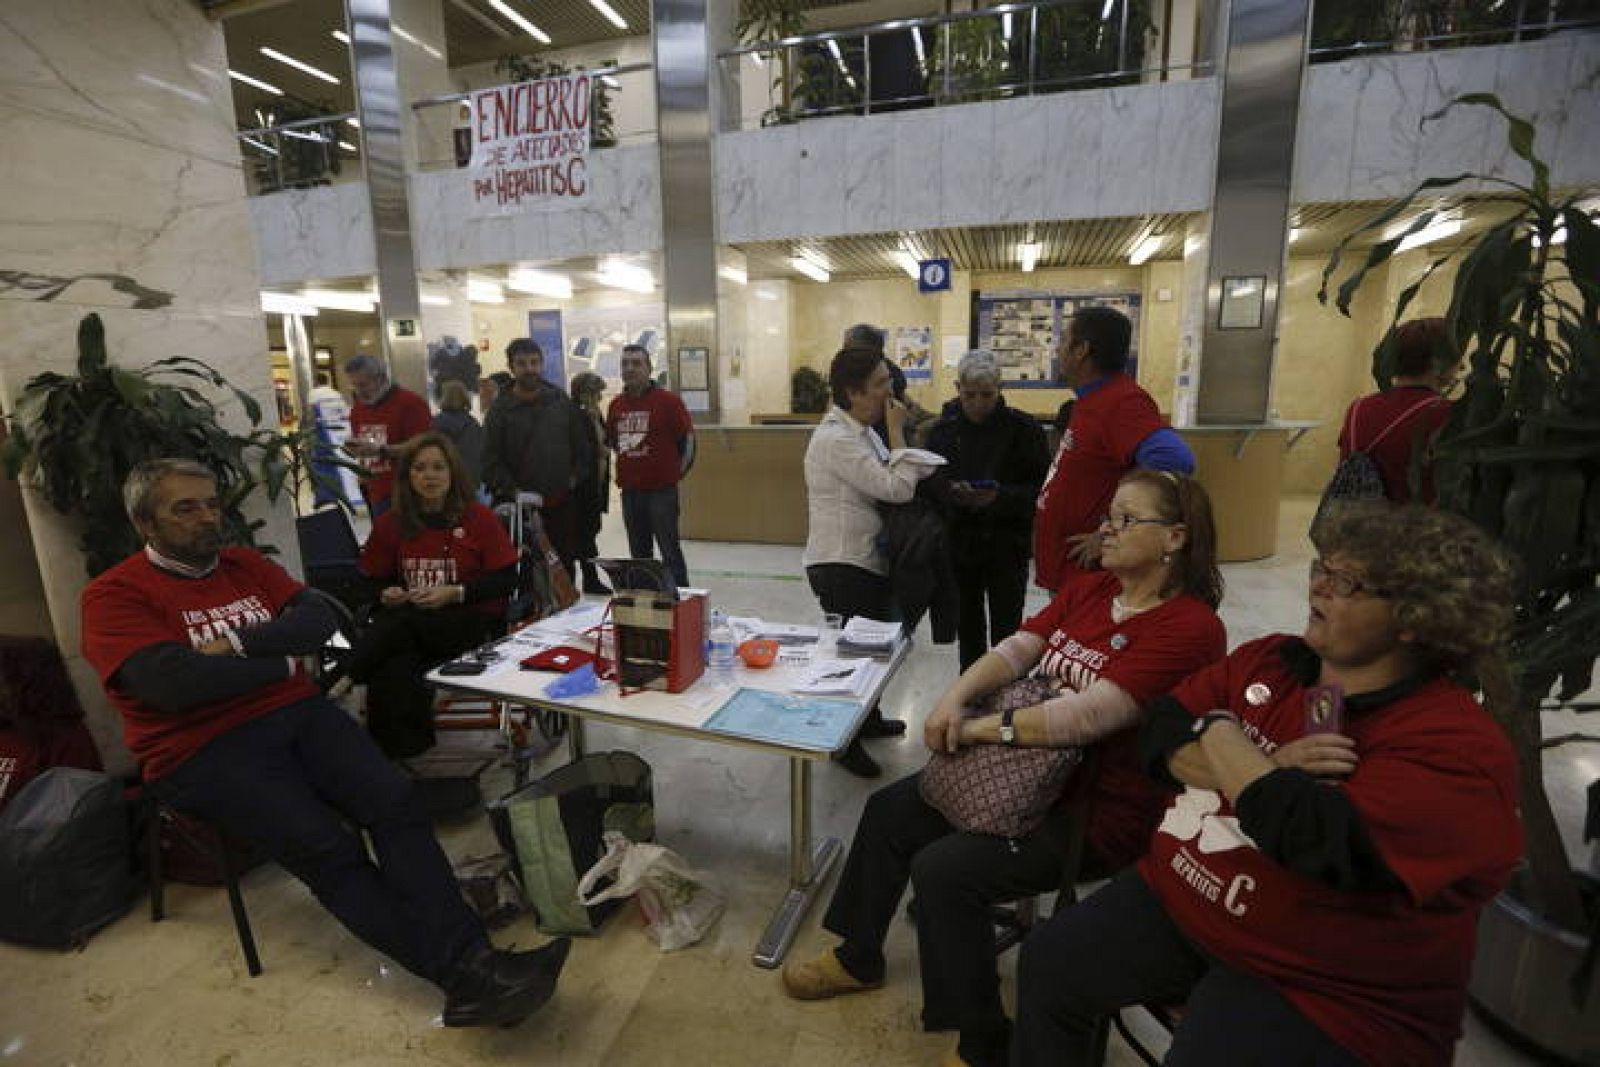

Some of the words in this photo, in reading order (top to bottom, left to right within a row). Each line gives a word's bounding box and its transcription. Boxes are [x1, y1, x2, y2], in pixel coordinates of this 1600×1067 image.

[477, 75, 590, 143] ENCIERRO
[568, 156, 586, 197] C
[1224, 873, 1256, 916] C
